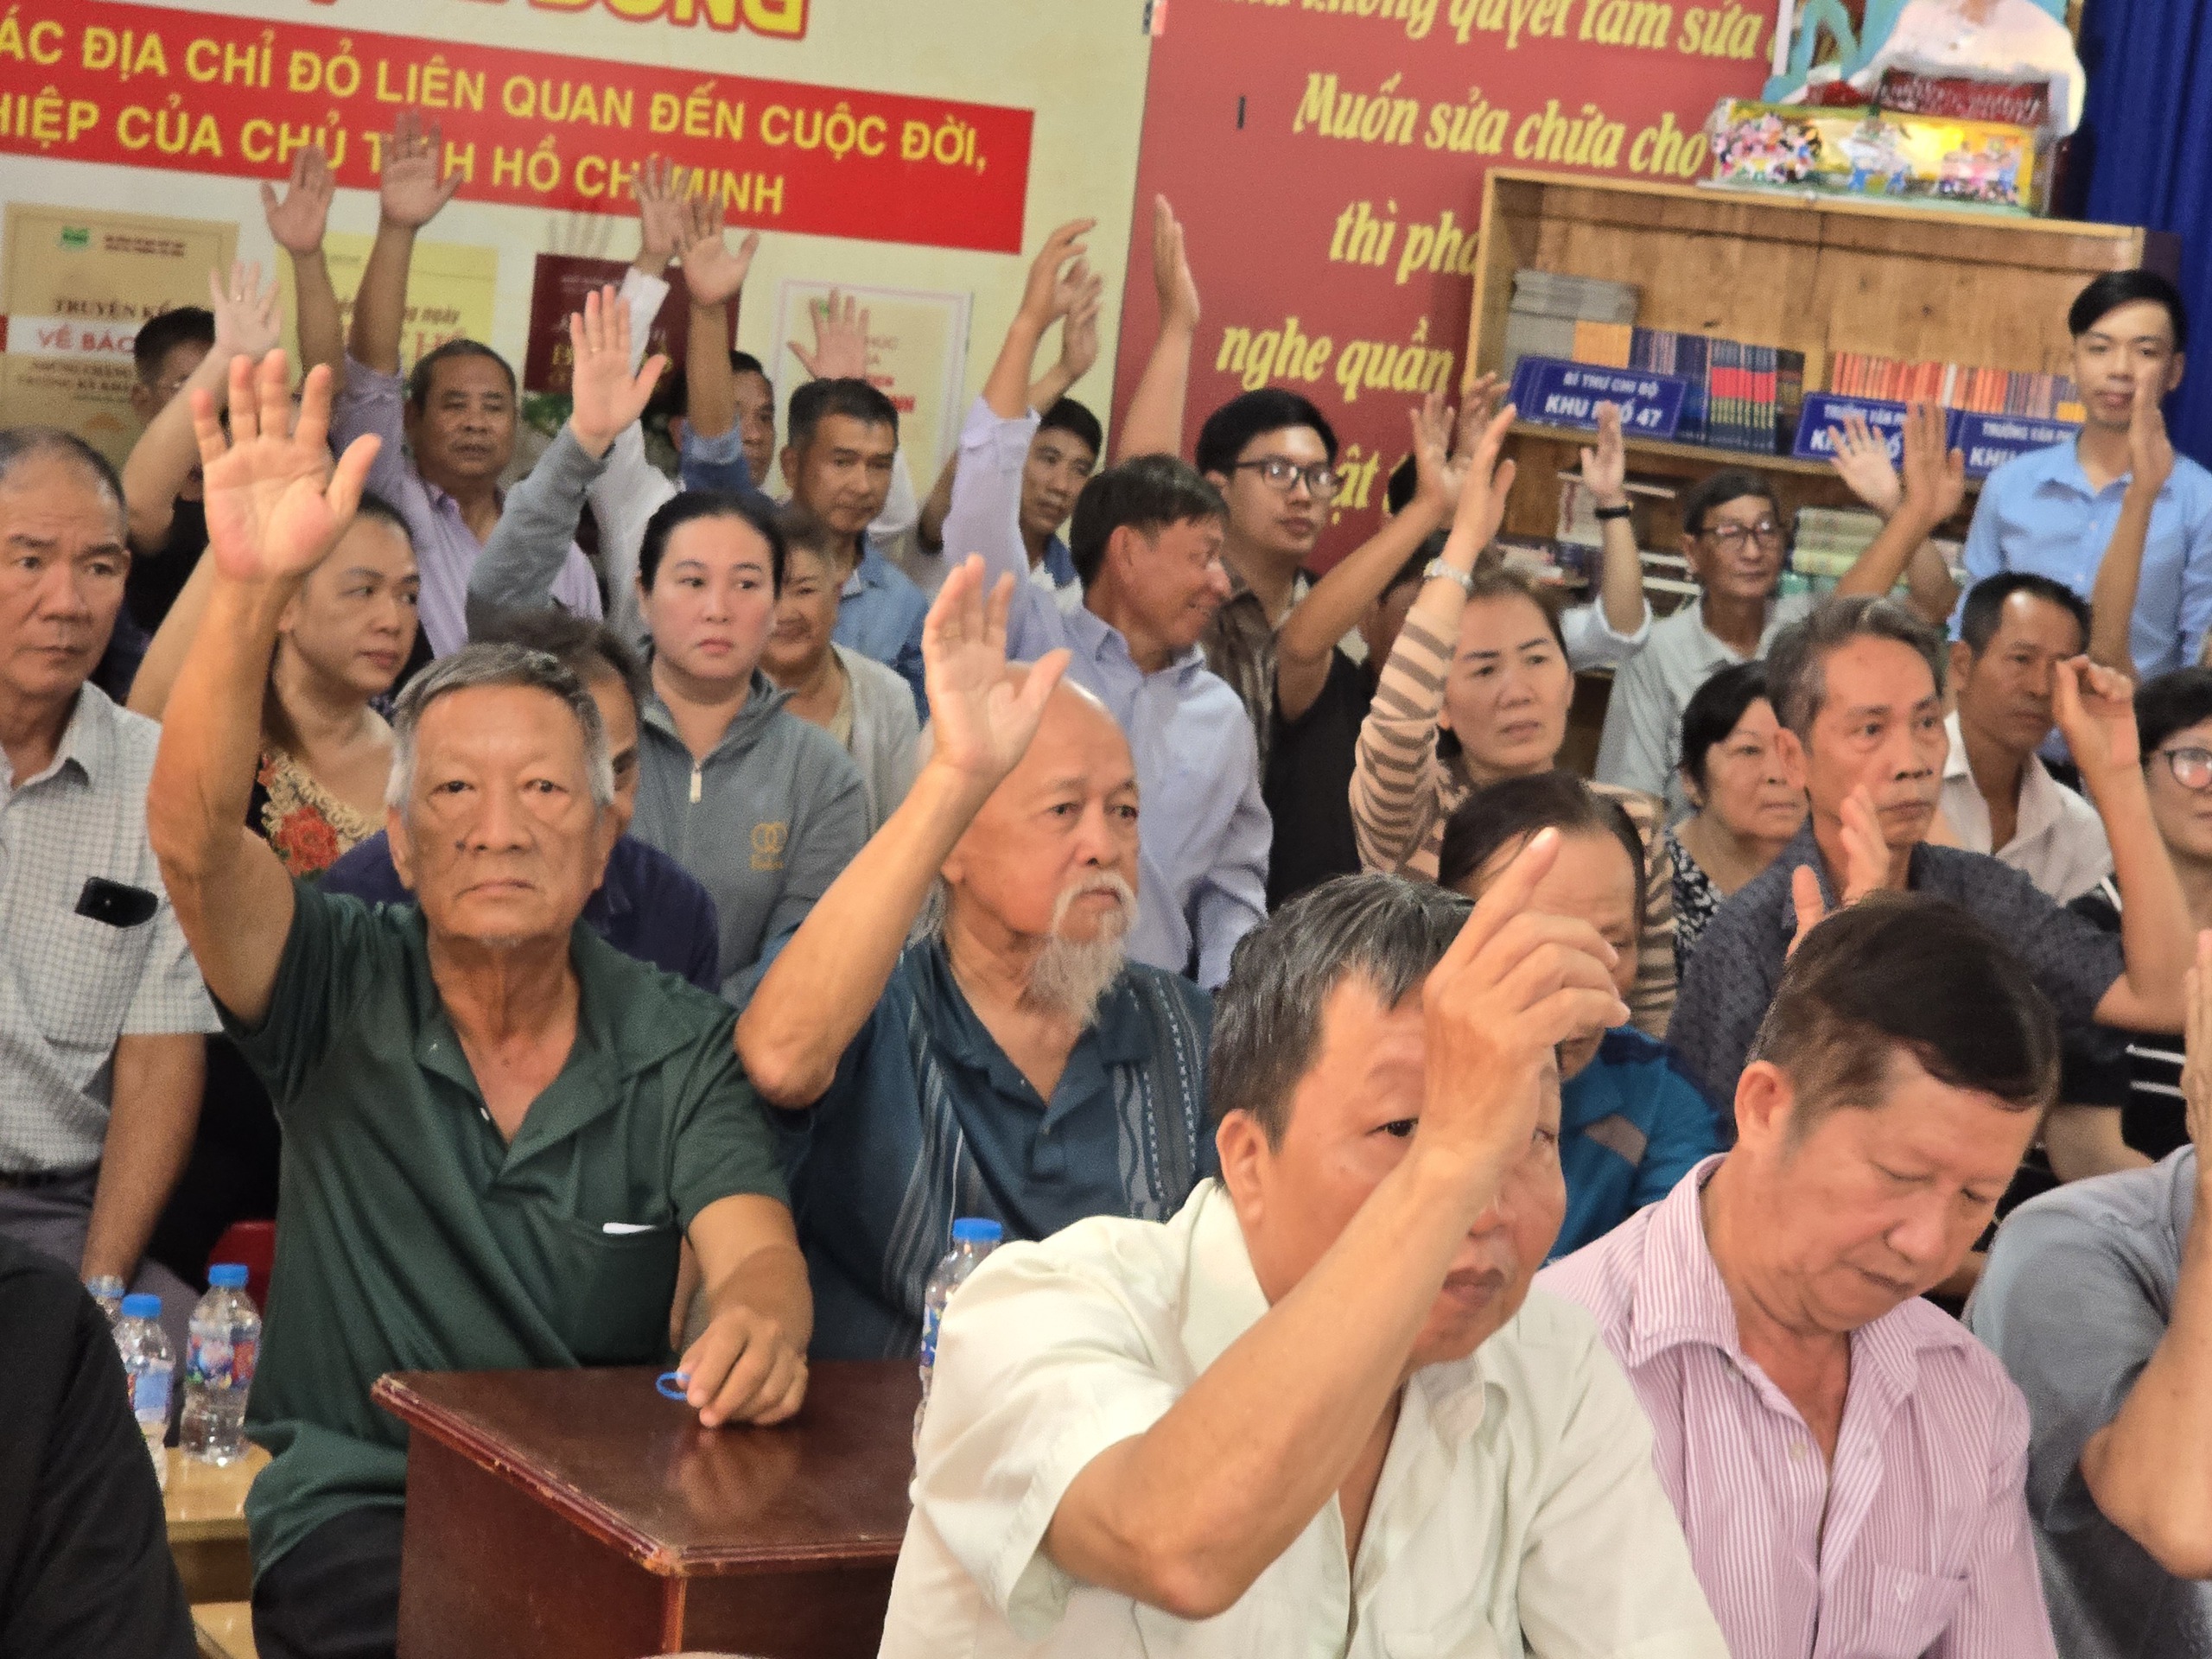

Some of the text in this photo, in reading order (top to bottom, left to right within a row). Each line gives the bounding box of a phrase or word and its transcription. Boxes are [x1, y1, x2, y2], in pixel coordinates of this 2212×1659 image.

[0, 3, 987, 175] ÁC ĐỊA CHỈ ĐỎ LIÊN QUAN ĐẾN CUỘC ĐỜI,
[1293, 70, 1709, 179] Muốn sửa chữa cho
[117, 92, 223, 157] CỦA
[361, 130, 475, 184] TH
[575, 150, 659, 200] CH
[1328, 196, 1398, 267] thì
[1215, 315, 1333, 392] nghe
[1544, 393, 1590, 418] KHU
[1637, 407, 1663, 429] 47
